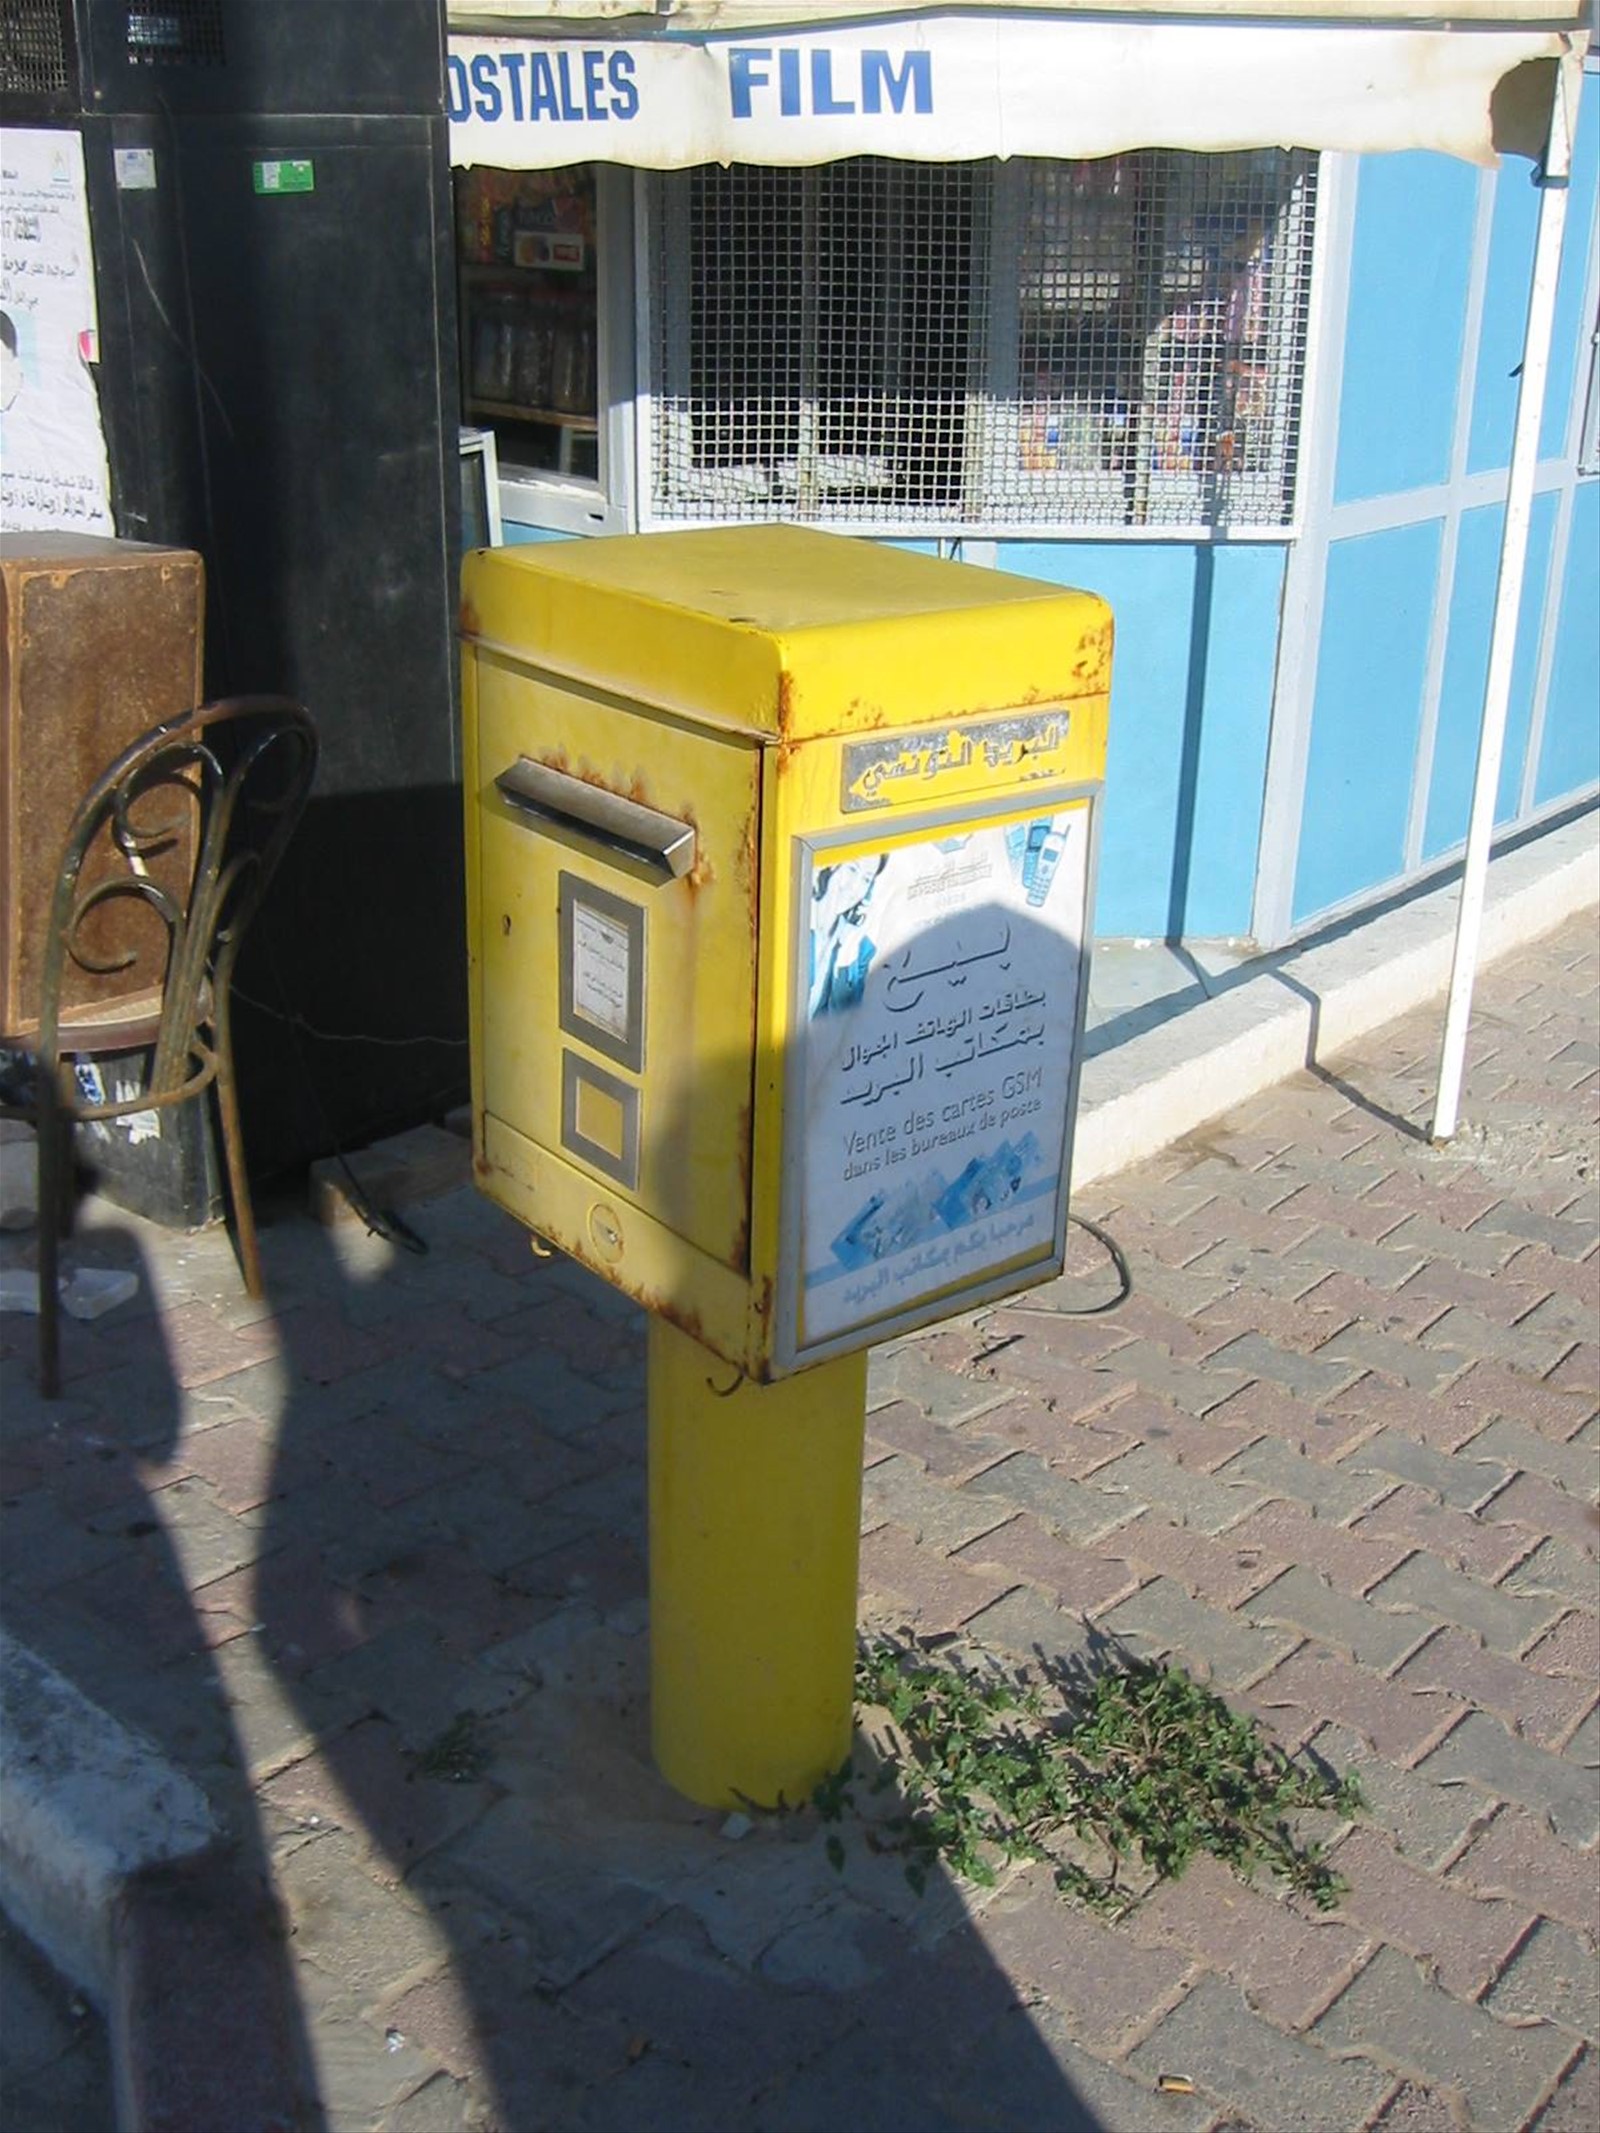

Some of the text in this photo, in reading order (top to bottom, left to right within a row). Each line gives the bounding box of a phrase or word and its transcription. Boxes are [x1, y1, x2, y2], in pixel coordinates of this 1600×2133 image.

[728, 47, 933, 119] FILM
[840, 1022, 1045, 1106] بمكاتب البريد
[842, 990, 1046, 1071] بطاقات الهاتف الجوال
[843, 1099, 1042, 1181] dans les bureaux de poste
[844, 1066, 1042, 1155] Vente des cartes GSM
